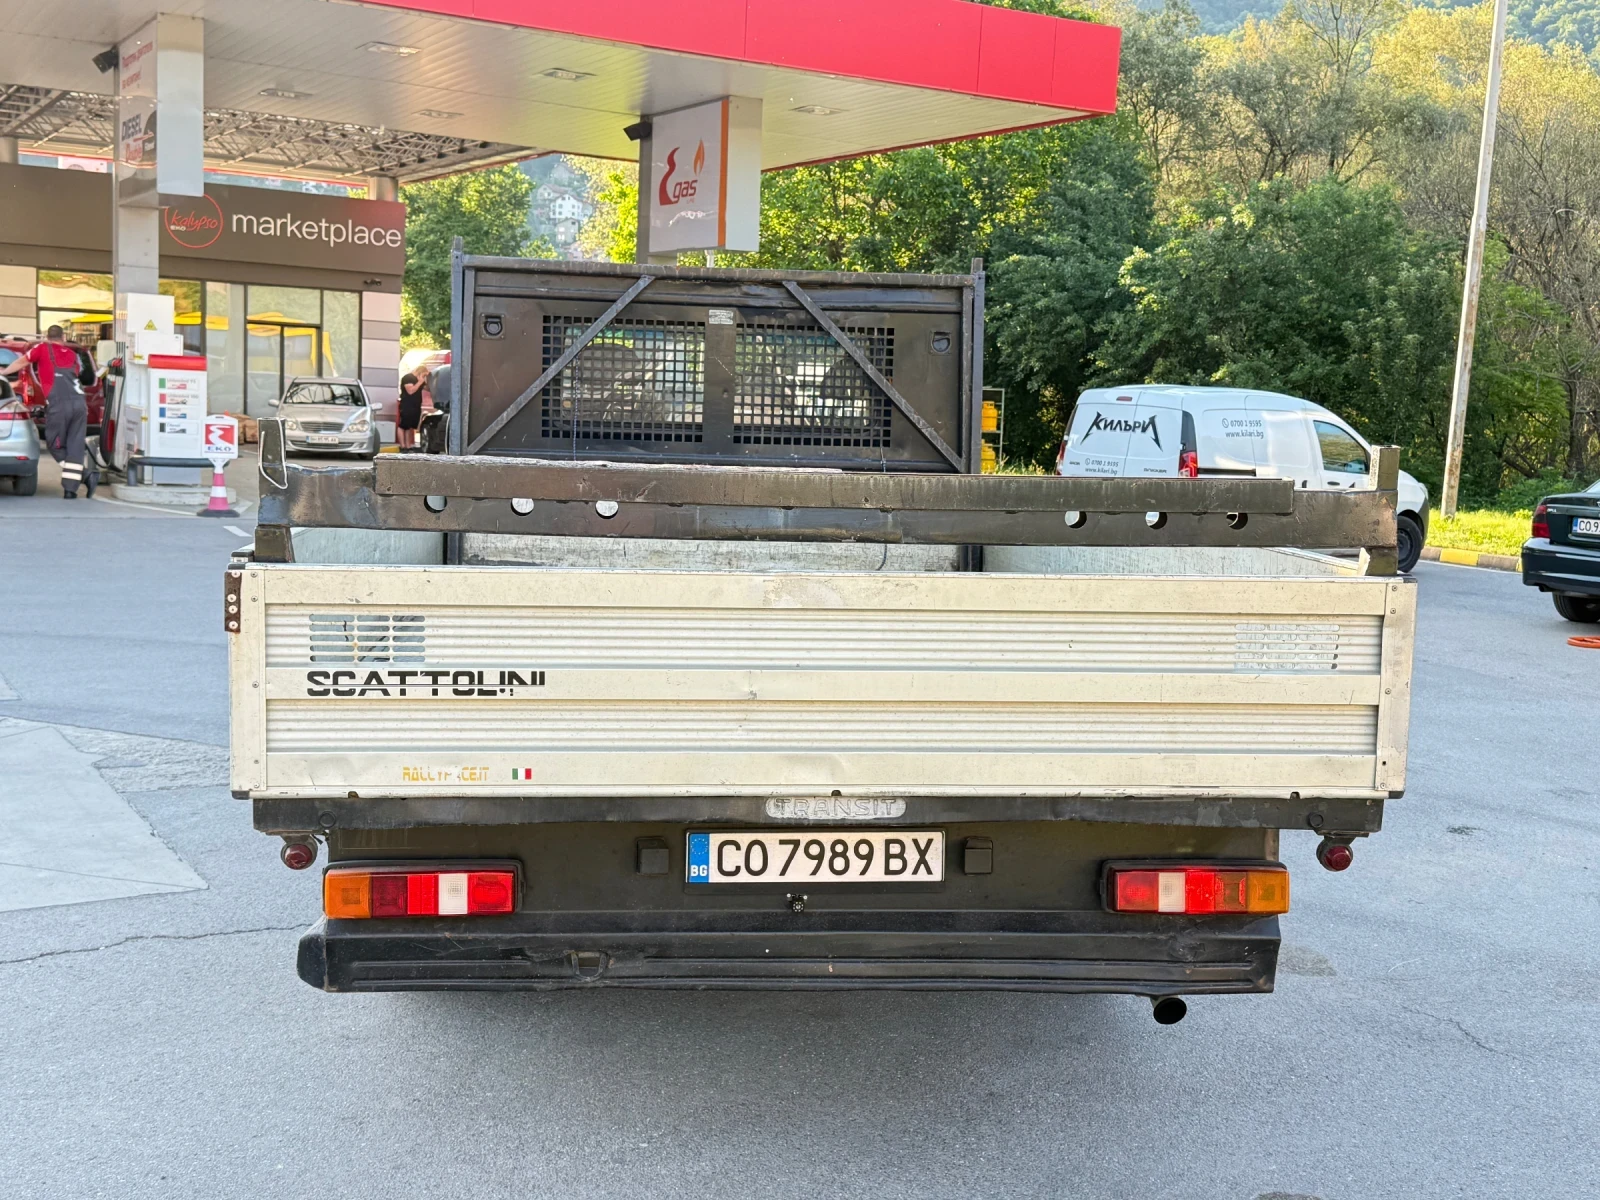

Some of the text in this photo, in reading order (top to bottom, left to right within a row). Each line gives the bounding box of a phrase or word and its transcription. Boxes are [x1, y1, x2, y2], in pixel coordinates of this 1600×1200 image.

[673, 179, 698, 203] gas
[232, 213, 402, 248] marketplace
[1230, 419, 1243, 427] 0700
[307, 670, 546, 697] SCATTOLINI
[775, 798, 897, 816] TRANSIT
[690, 864, 708, 877] BG
